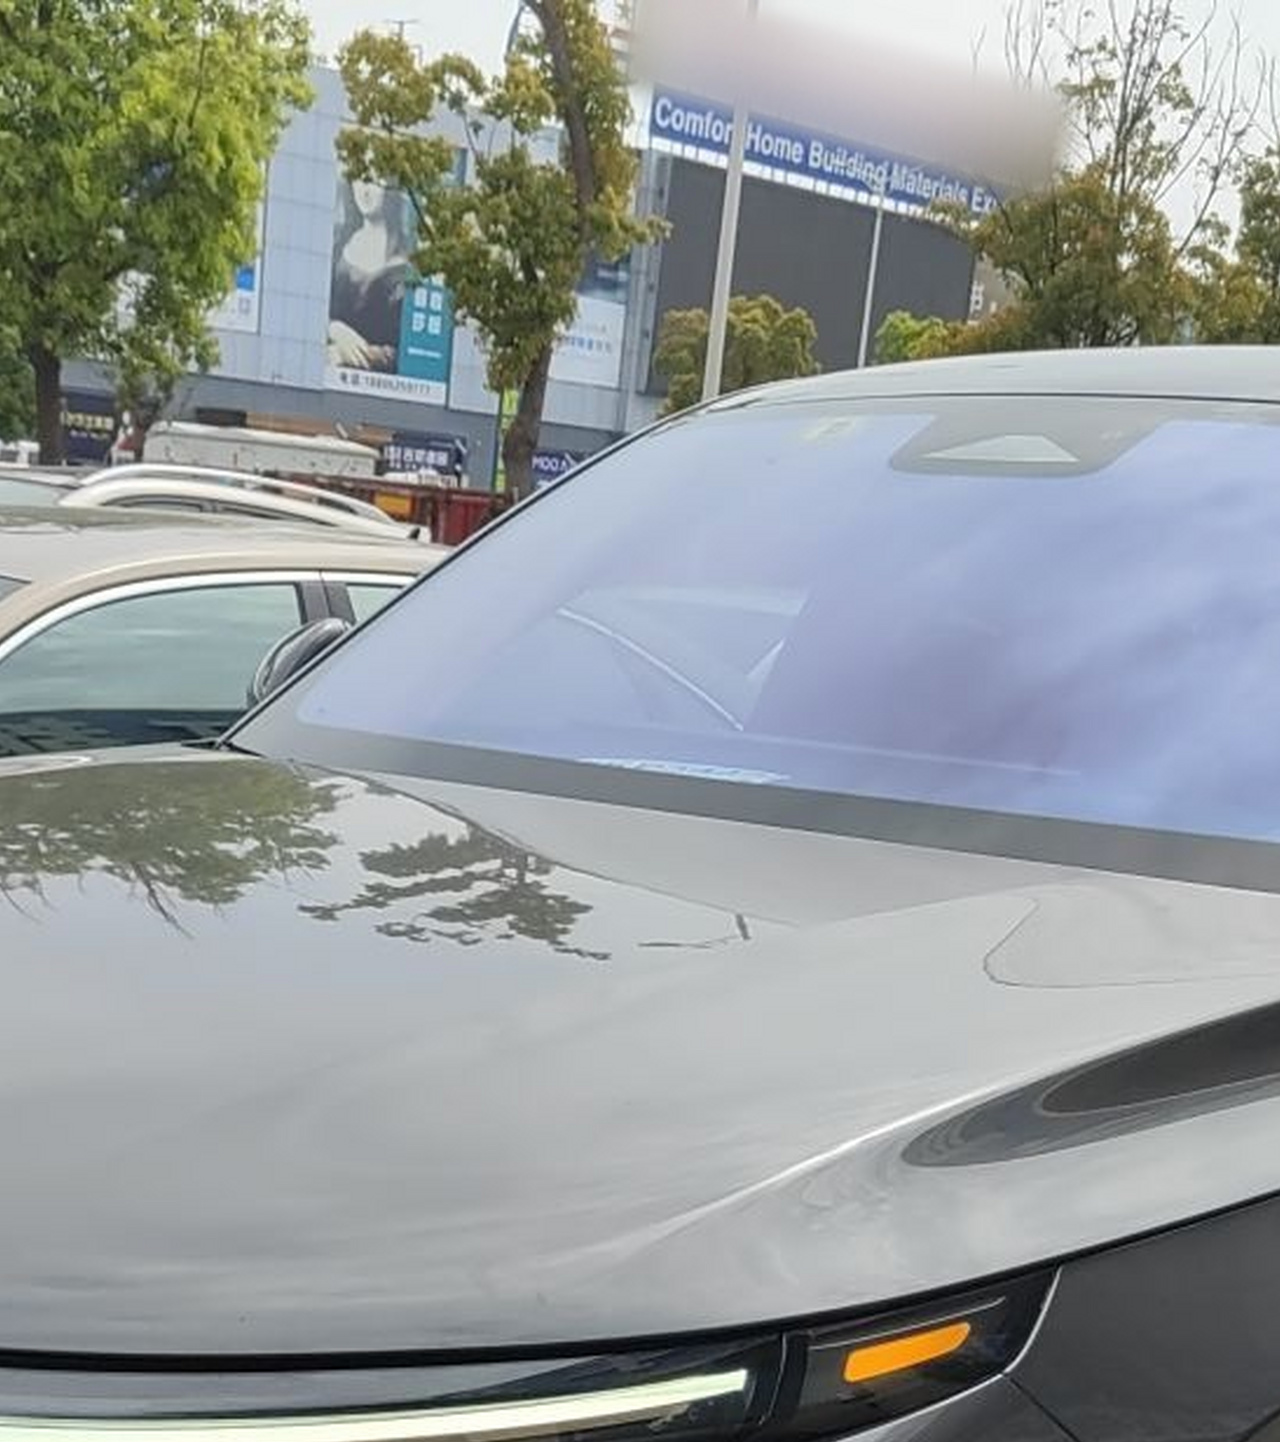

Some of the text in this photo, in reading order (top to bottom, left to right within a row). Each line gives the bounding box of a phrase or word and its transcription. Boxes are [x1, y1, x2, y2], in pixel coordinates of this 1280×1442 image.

[654, 97, 733, 145] Comfor
[745, 121, 803, 163] Home
[808, 140, 888, 190] Building
[889, 161, 970, 202] Materials
